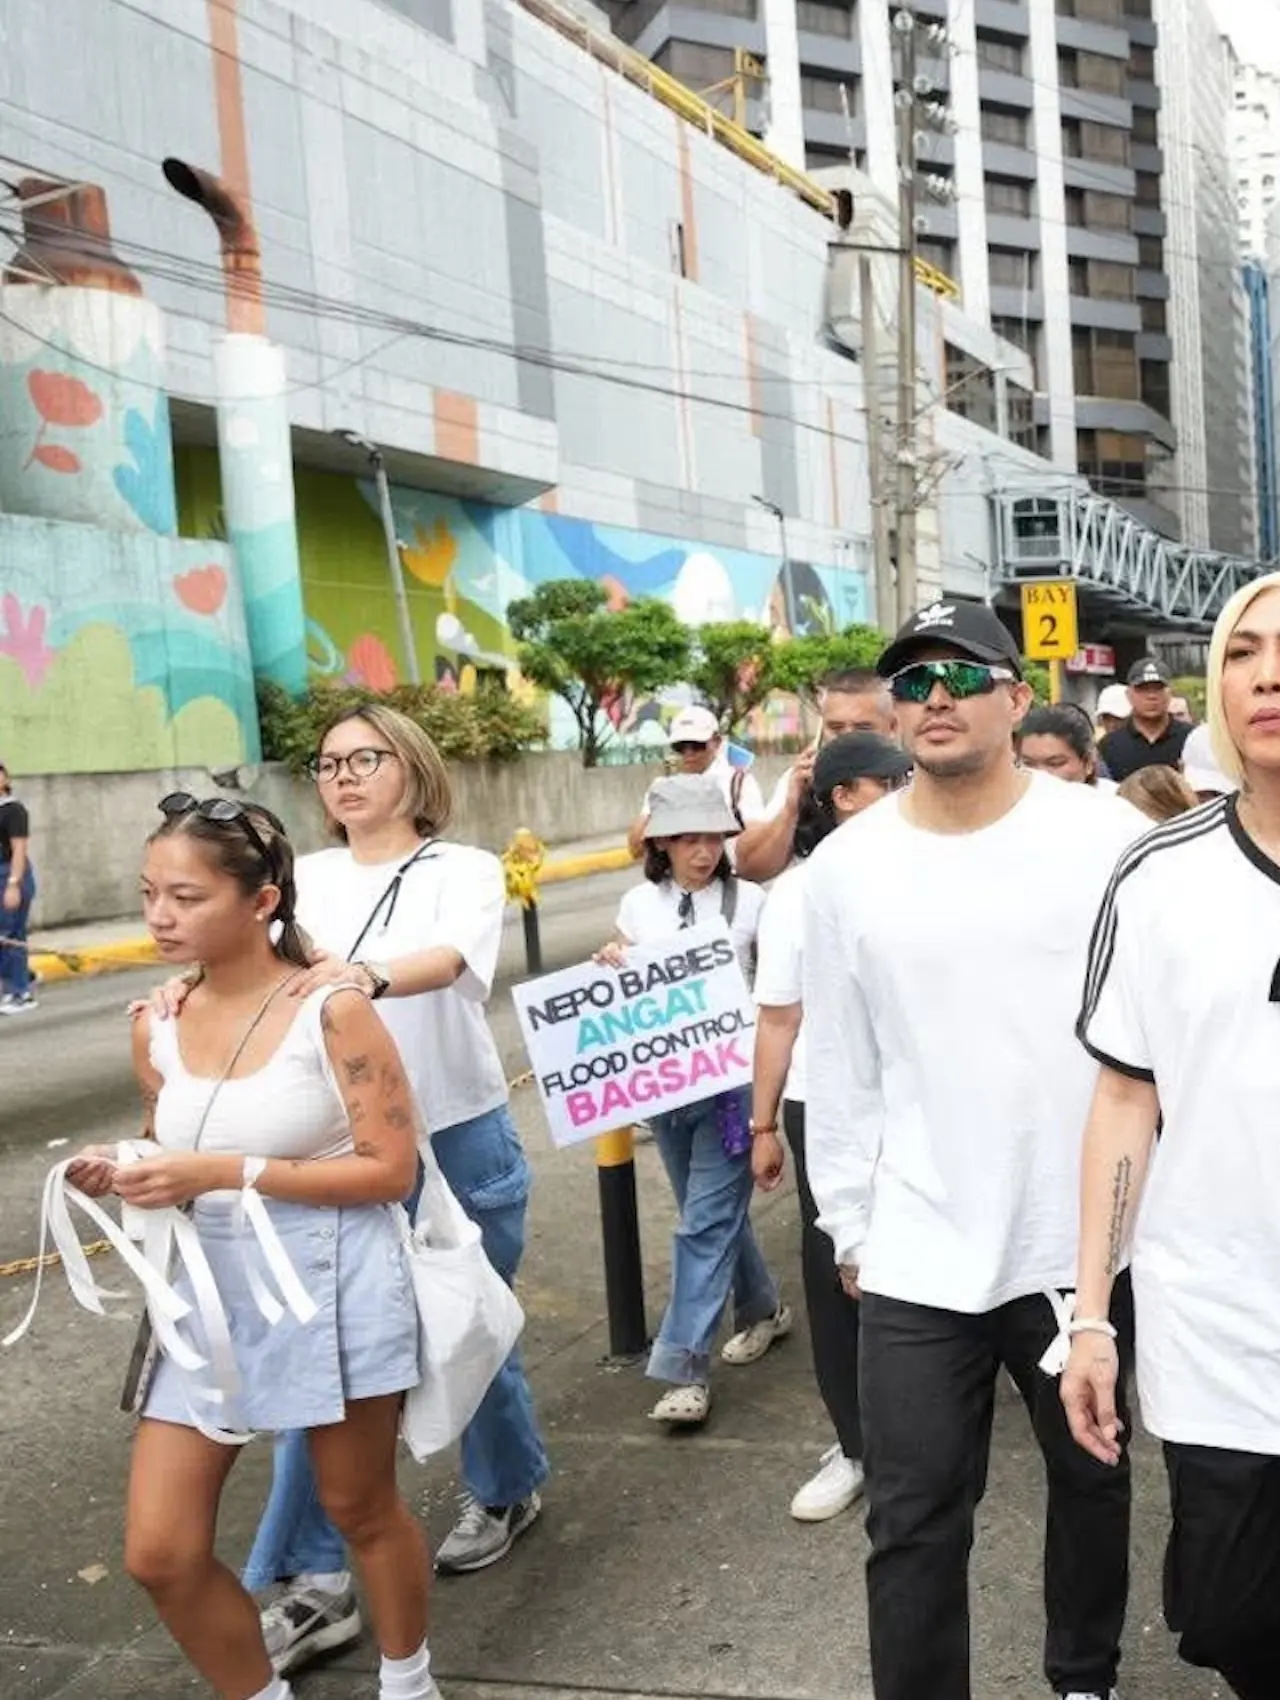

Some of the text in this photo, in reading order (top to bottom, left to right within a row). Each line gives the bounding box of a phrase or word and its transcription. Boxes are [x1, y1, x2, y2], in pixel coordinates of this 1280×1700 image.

[1027, 586, 1070, 604] BAY
[1040, 614, 1059, 647] 2
[526, 938, 735, 1032] NEPO BABIES
[576, 979, 709, 1054] ANGAT
[542, 1009, 755, 1098] FLOOD CONTROL
[565, 1038, 751, 1127] BAGSAK
